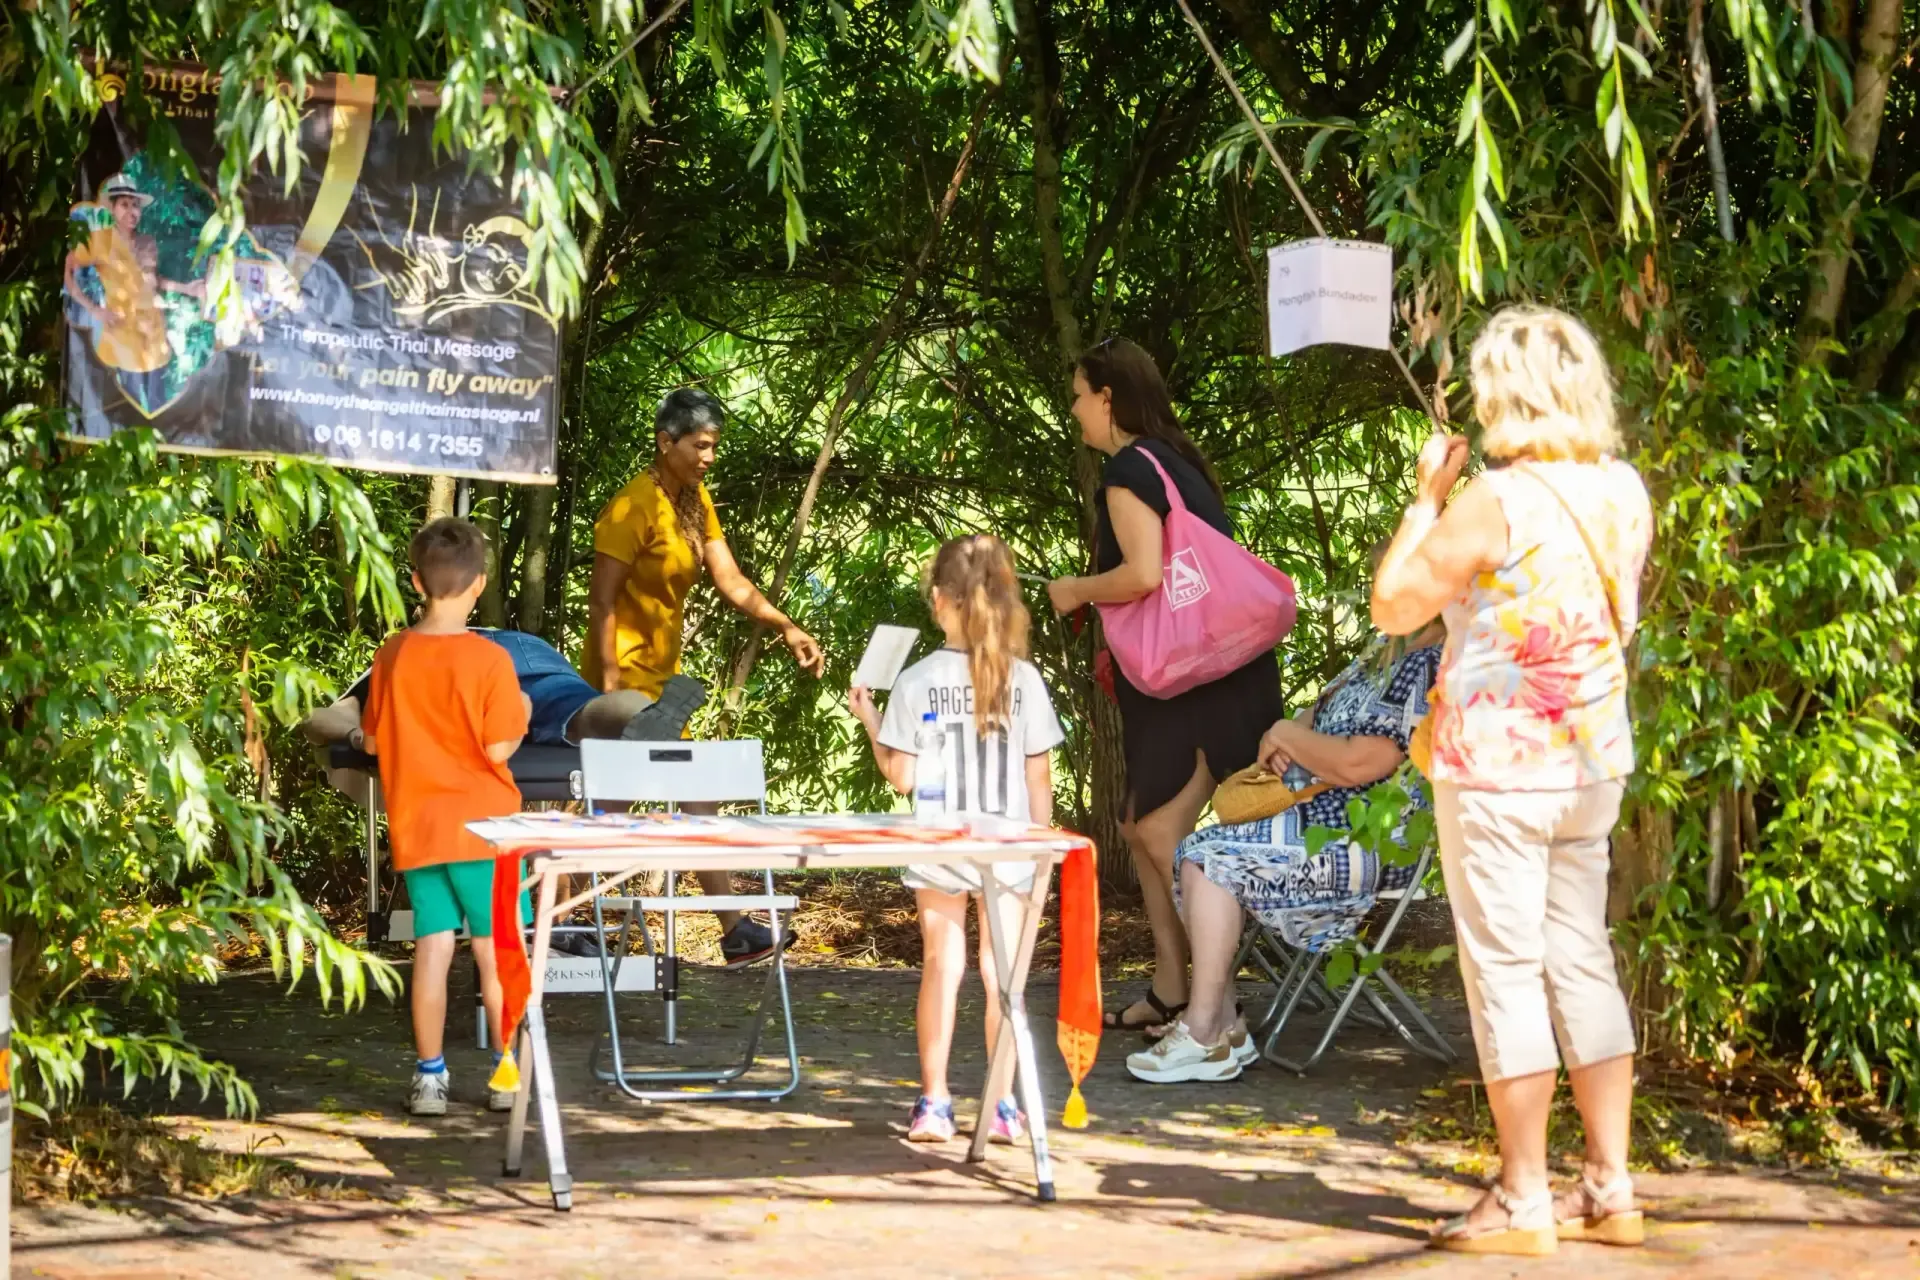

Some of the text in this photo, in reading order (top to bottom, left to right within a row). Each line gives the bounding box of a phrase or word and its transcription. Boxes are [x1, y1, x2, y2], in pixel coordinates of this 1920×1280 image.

[280, 324, 516, 362] Therapeutic Thai Massage
[298, 356, 355, 380] your
[359, 363, 420, 389] pain
[427, 367, 464, 396] fly
[469, 374, 553, 401] away"
[427, 433, 484, 457] 7355
